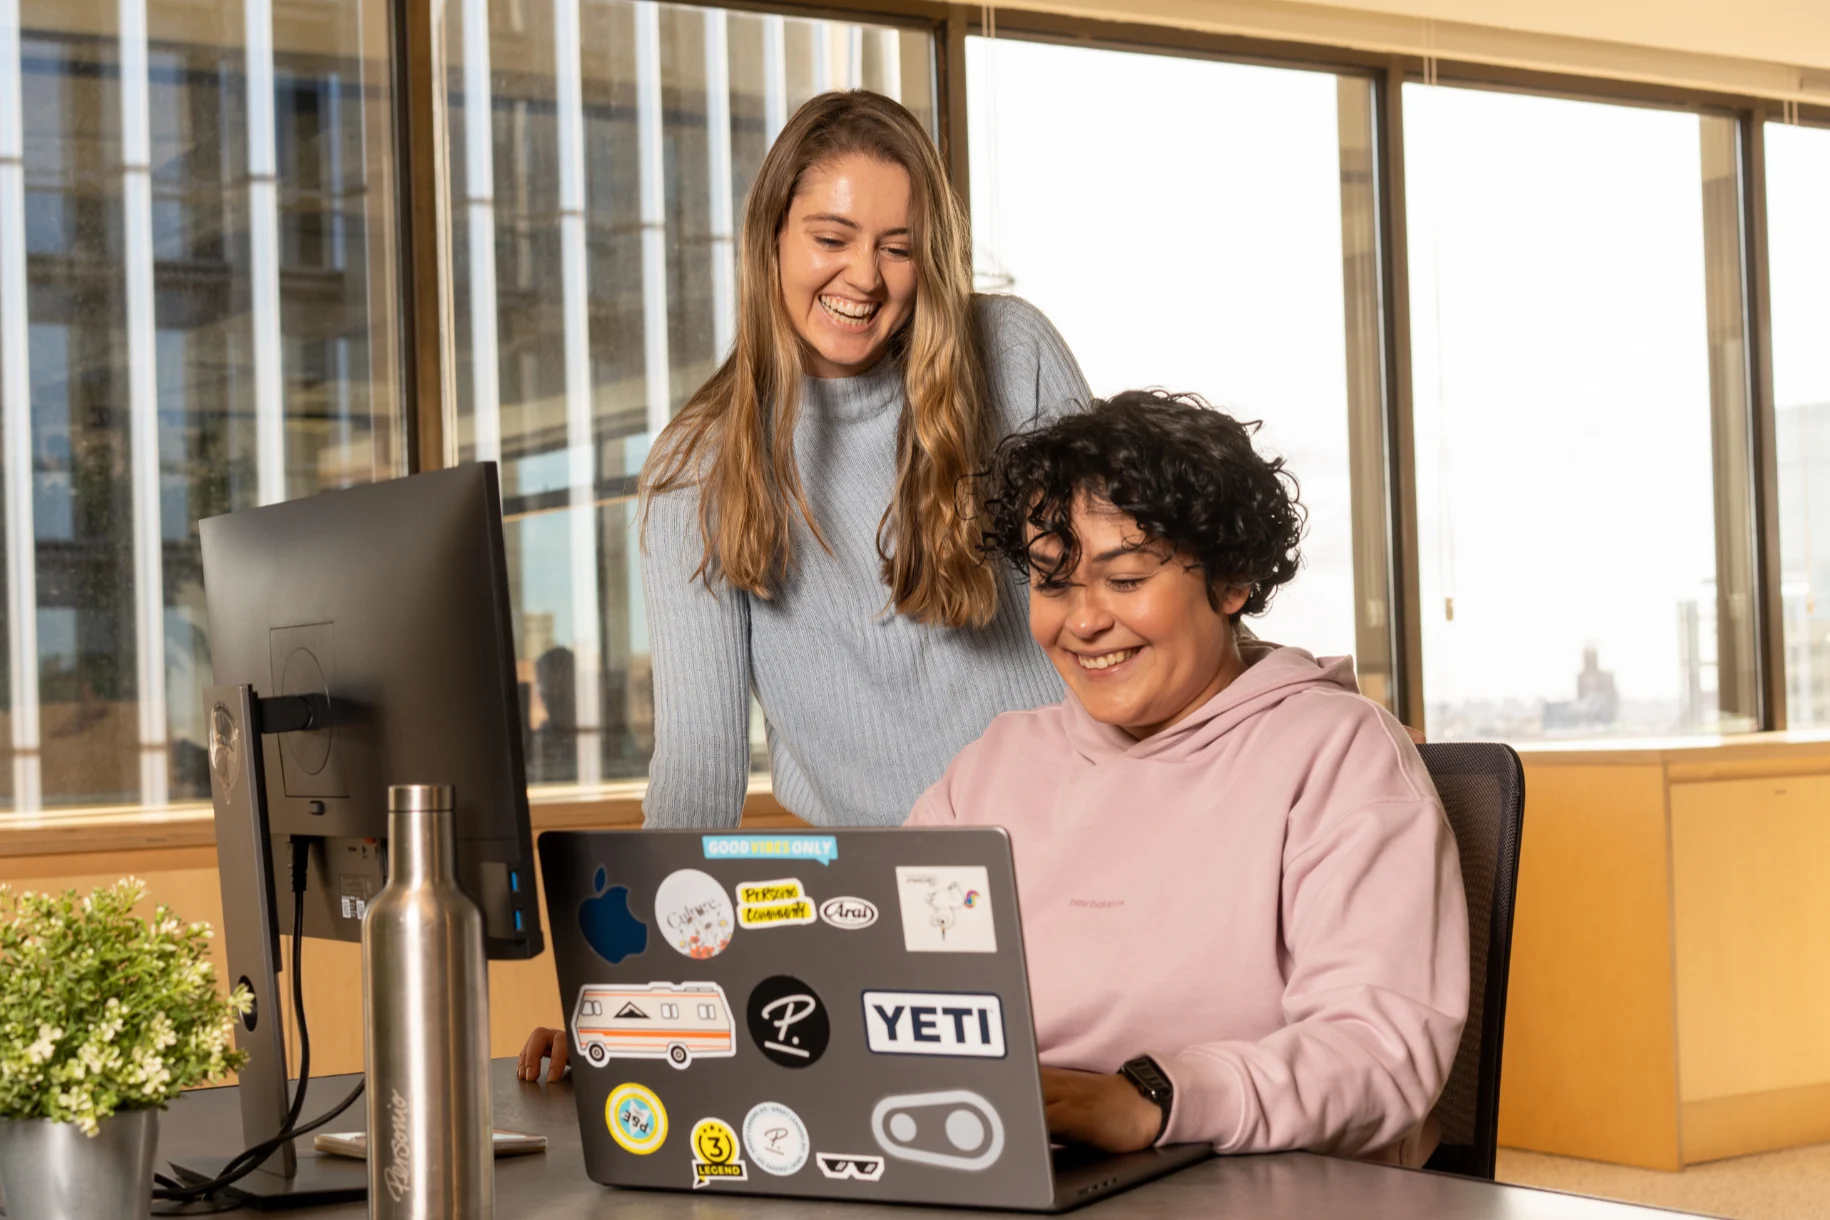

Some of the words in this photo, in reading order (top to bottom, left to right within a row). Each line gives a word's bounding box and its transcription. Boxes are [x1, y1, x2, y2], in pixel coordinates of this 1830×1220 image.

[708, 840, 749, 854] GOOD
[750, 840, 790, 854] VIBES
[792, 840, 832, 855] ONLY
[833, 901, 868, 920] Arai
[872, 1004, 992, 1044] YETI
[384, 1088, 411, 1203] Personio
[707, 1137, 723, 1157] 3
[698, 1164, 741, 1176] LEGEND
